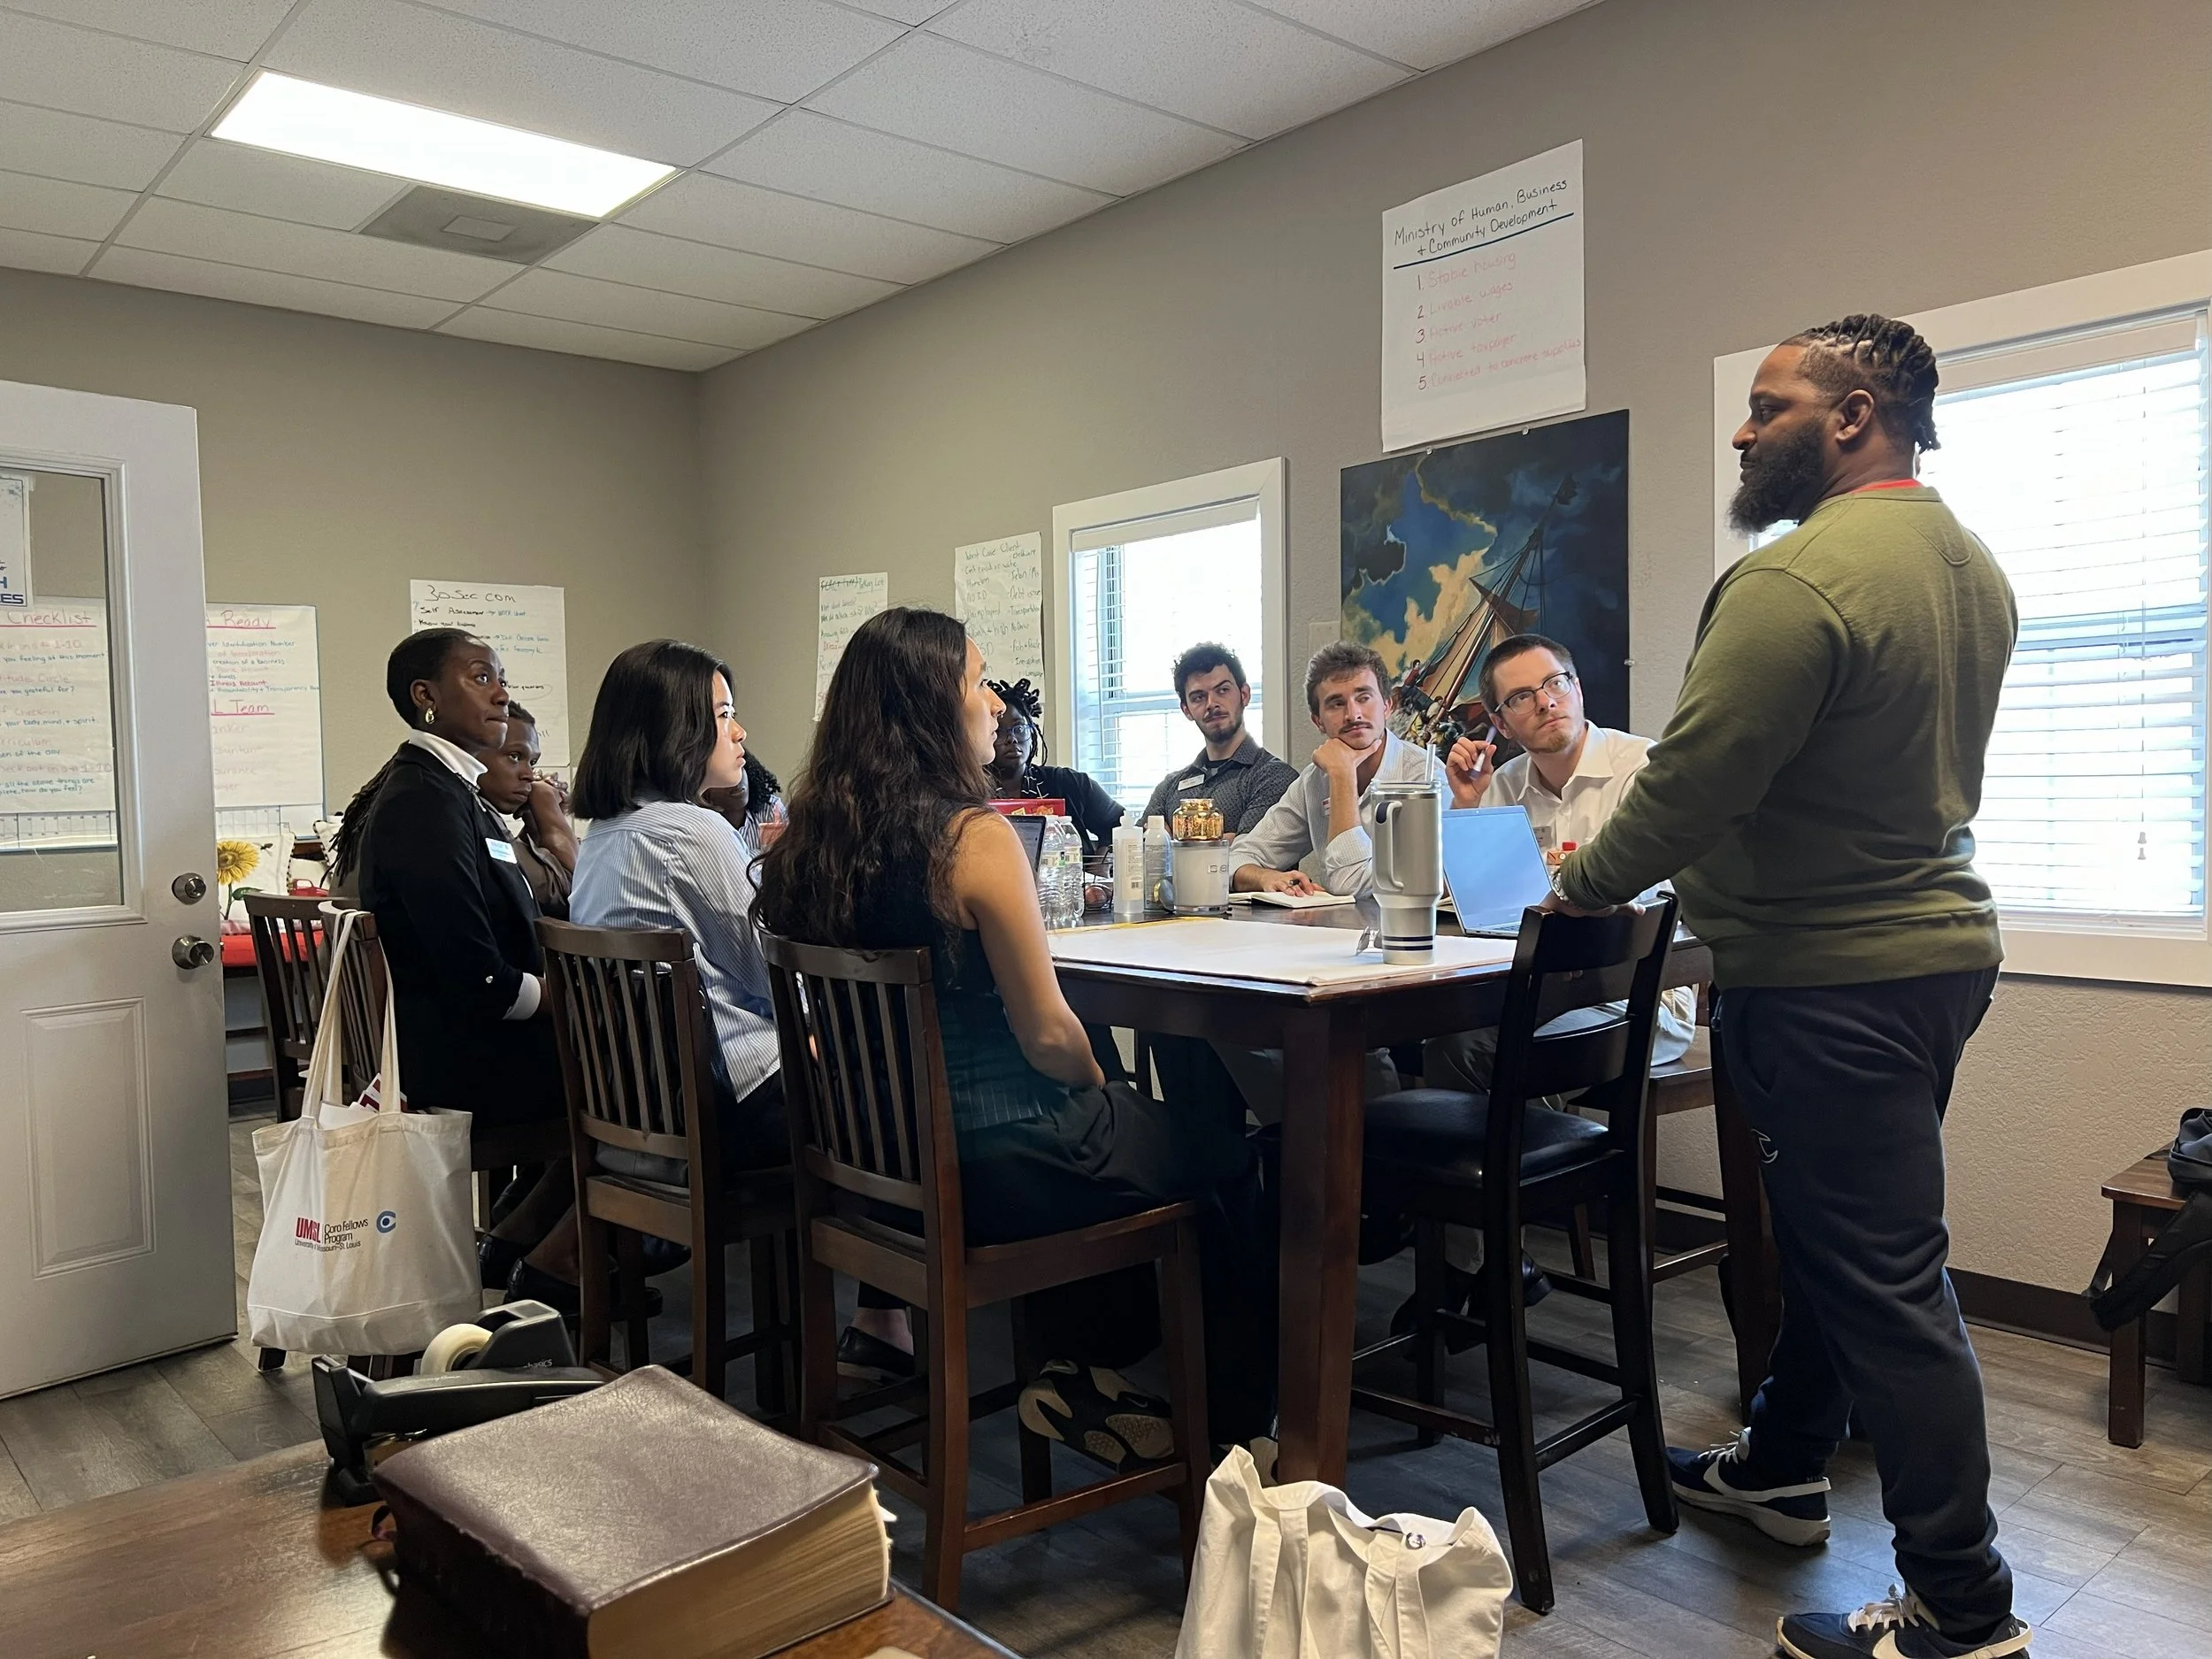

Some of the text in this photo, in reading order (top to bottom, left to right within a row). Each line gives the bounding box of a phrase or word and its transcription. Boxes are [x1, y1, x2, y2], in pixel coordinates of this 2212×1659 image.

[1394, 221, 1445, 245] Ministry
[1451, 211, 1464, 227] of
[1517, 180, 1567, 204] Business
[1429, 226, 1486, 253] Community
[1490, 199, 1557, 233] Development
[7, 608, 92, 625] Checklist
[220, 610, 270, 627] Ready
[228, 699, 271, 714] Team
[296, 1217, 321, 1243] UMSL
[342, 1218, 369, 1232] Fellows
[324, 1233, 353, 1245] Program
